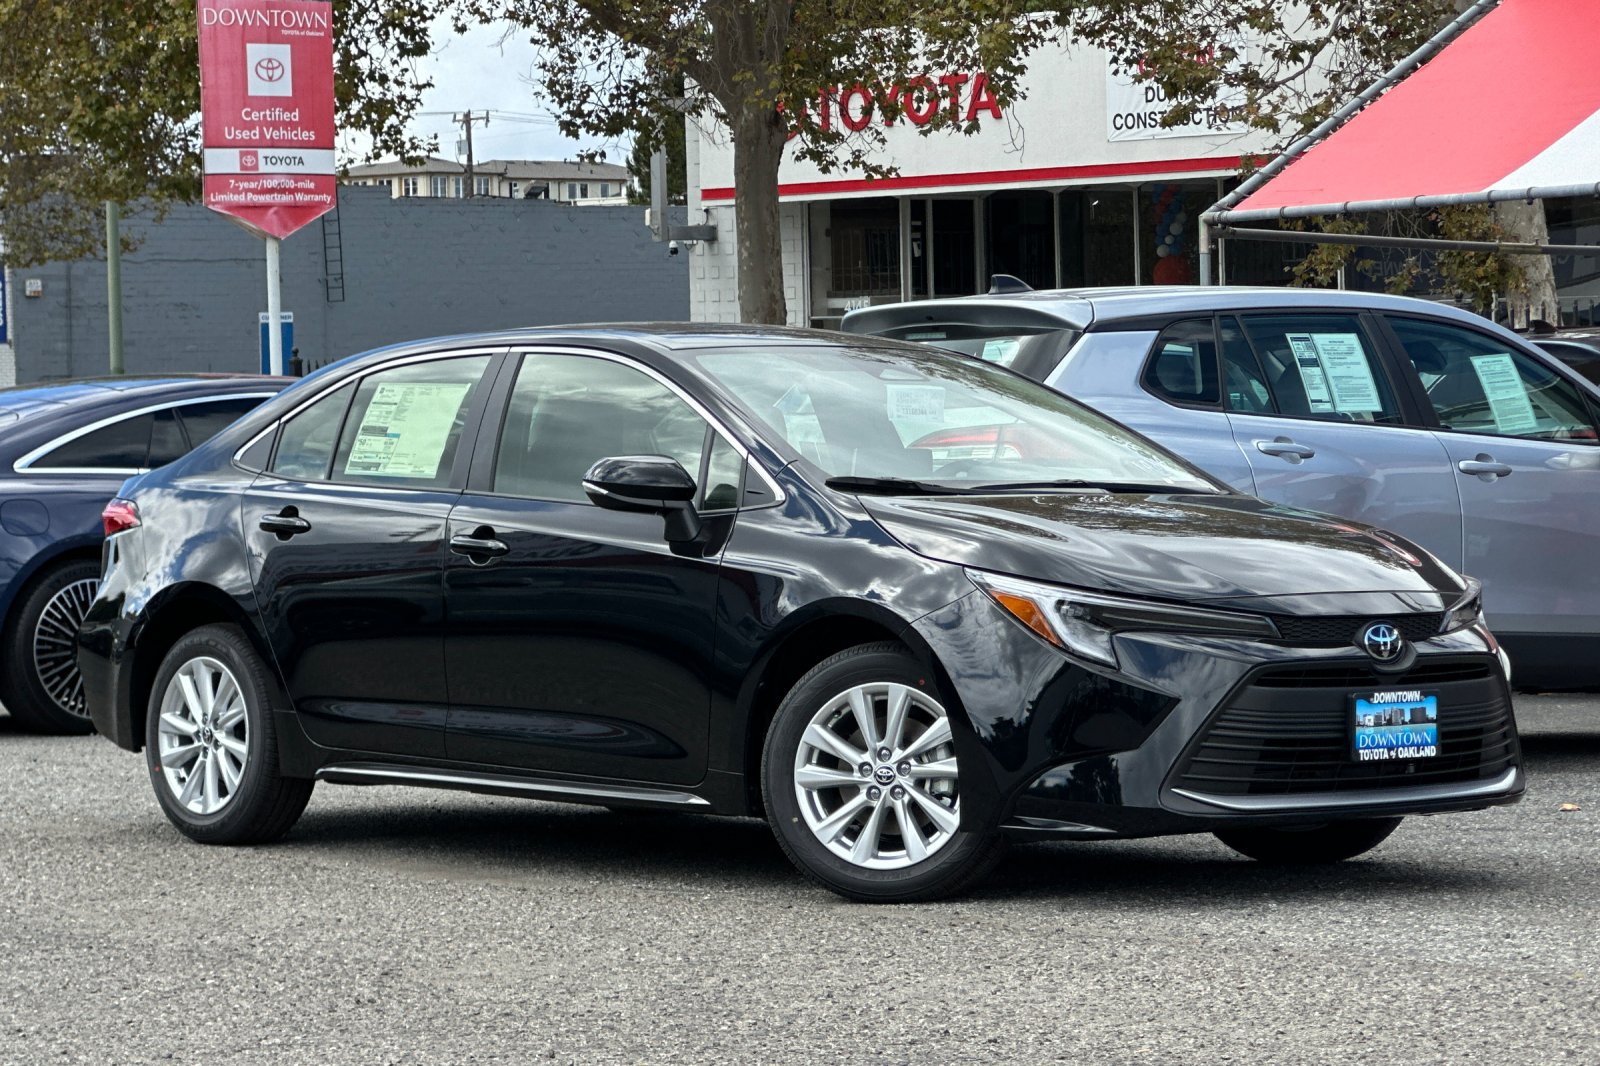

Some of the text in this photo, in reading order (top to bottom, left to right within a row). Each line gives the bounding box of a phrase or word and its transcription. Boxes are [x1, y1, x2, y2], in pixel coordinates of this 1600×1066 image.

[203, 8, 327, 29] DOWNTOWN
[241, 107, 299, 121] Certified
[224, 127, 316, 141] Used Vehicles
[263, 156, 304, 166] TOYOTA
[210, 192, 332, 204] Limited Powertrain Warranty
[1373, 690, 1421, 703] DOWNTOWN
[1360, 732, 1432, 748] DOWNTOWN
[1359, 748, 1389, 761] TOYOTA
[1397, 745, 1437, 759] OAKLAND
